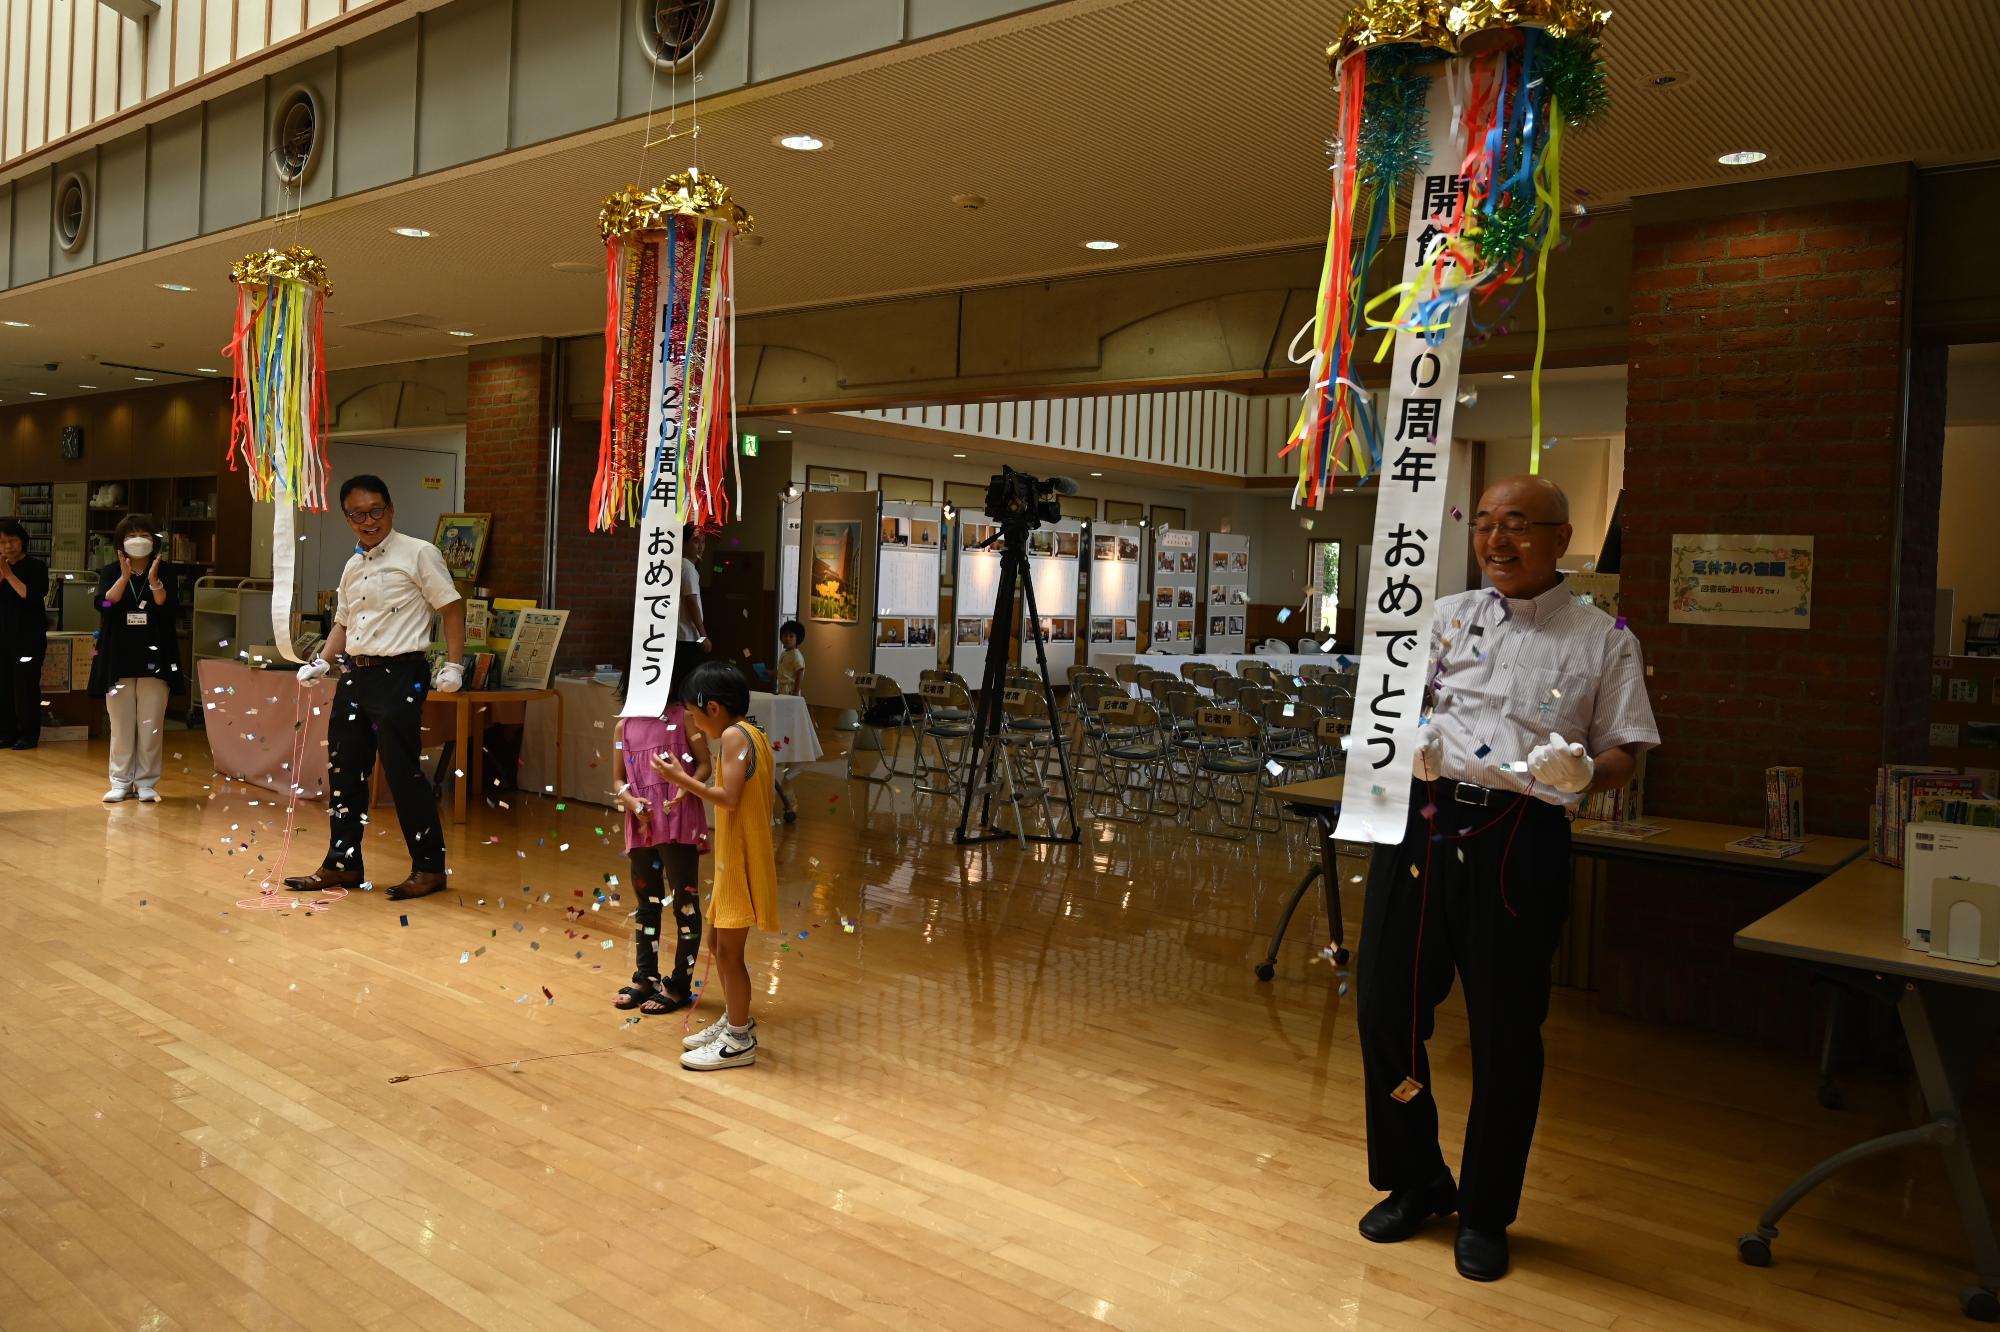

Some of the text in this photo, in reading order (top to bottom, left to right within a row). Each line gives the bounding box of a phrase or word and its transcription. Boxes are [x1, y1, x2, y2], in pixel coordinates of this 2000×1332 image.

[642, 526, 675, 686] おめでとう
[1367, 522, 1428, 770] おめでとう
[923, 684, 945, 694] 記者席
[1005, 691, 1020, 701] 者席
[1103, 700, 1129, 711] 記者席
[1204, 712, 1232, 725] 記者席
